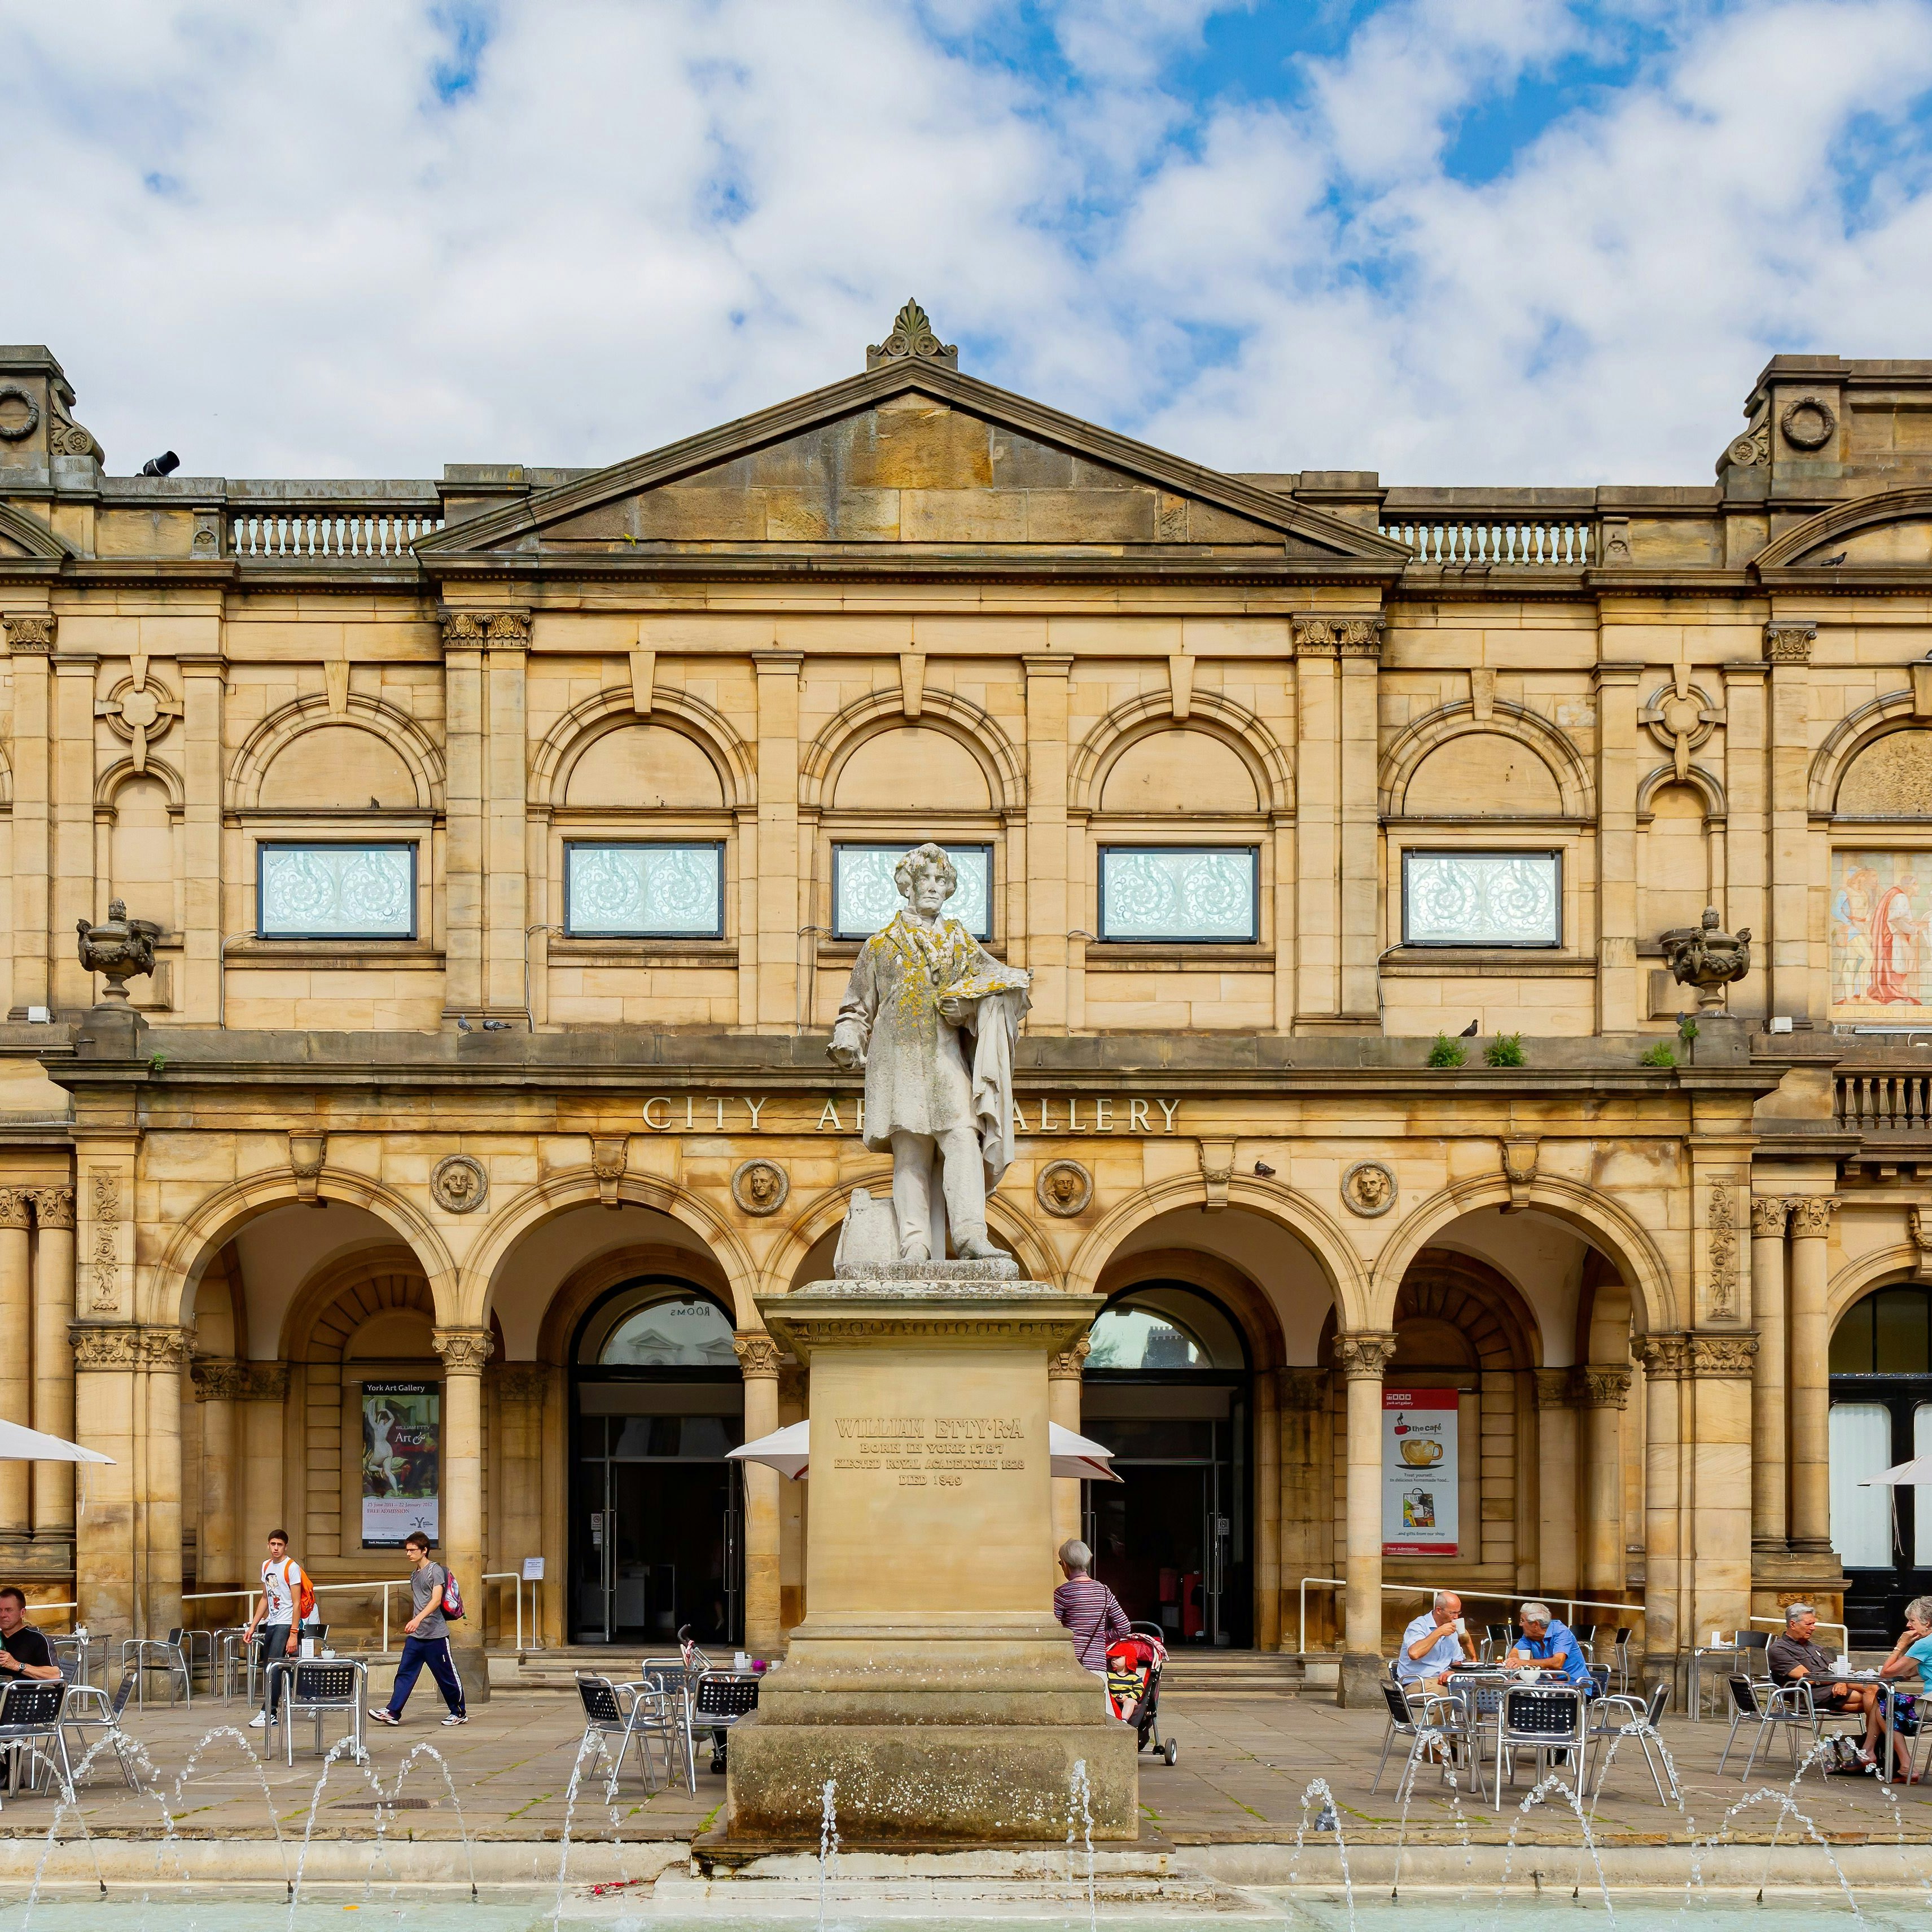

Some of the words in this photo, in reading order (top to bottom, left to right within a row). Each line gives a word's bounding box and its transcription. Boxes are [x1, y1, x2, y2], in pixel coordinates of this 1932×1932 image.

[642, 1097, 768, 1129] CITY
[1013, 1098, 1181, 1131] ALLERY
[398, 1385, 425, 1393] Gallery
[835, 1418, 925, 1438] WILLIAM
[1425, 1423, 1442, 1433] café
[395, 1432, 411, 1442] Art
[413, 1431, 426, 1445] &
[860, 1443, 901, 1453] BORN
[906, 1443, 922, 1454] IN
[926, 1443, 966, 1454] YORK
[970, 1443, 1004, 1455] 1787
[834, 1458, 881, 1469] ELECTED
[886, 1458, 921, 1470] ROYAL
[925, 1459, 998, 1470] ACADEMICIAN
[1001, 1459, 1025, 1470] 1828
[899, 1474, 927, 1486] DIED
[933, 1474, 963, 1486] 1849
